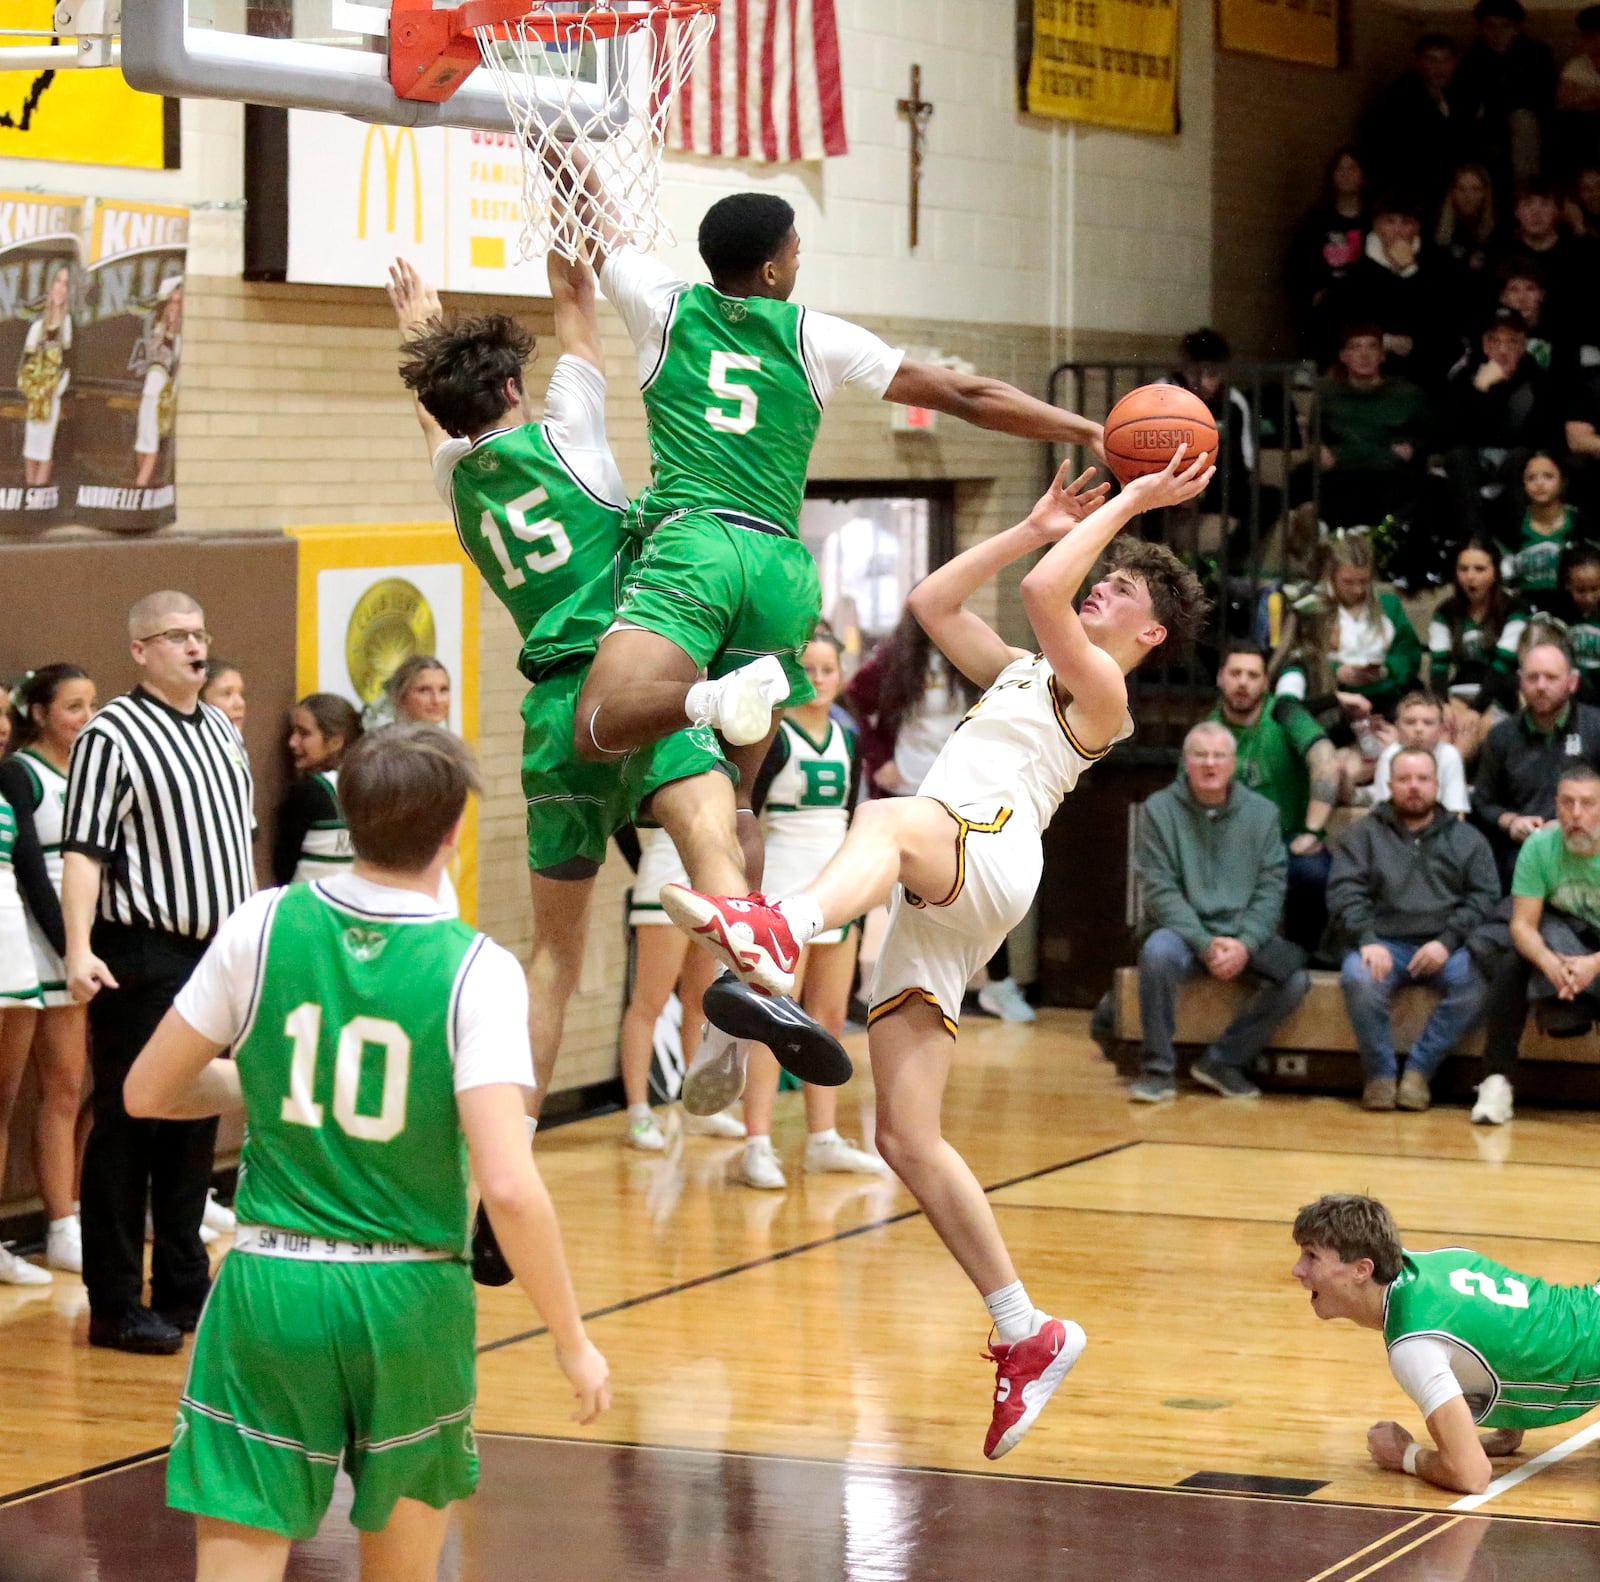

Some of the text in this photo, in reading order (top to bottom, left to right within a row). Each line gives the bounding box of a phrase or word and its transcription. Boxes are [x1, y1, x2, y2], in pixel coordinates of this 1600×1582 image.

[704, 349, 761, 435] 5
[1133, 429, 1195, 450] OHSAA
[480, 485, 573, 590] 15
[796, 757, 848, 809] B
[280, 1001, 412, 1144] 10
[1449, 1268, 1530, 1309] 2
